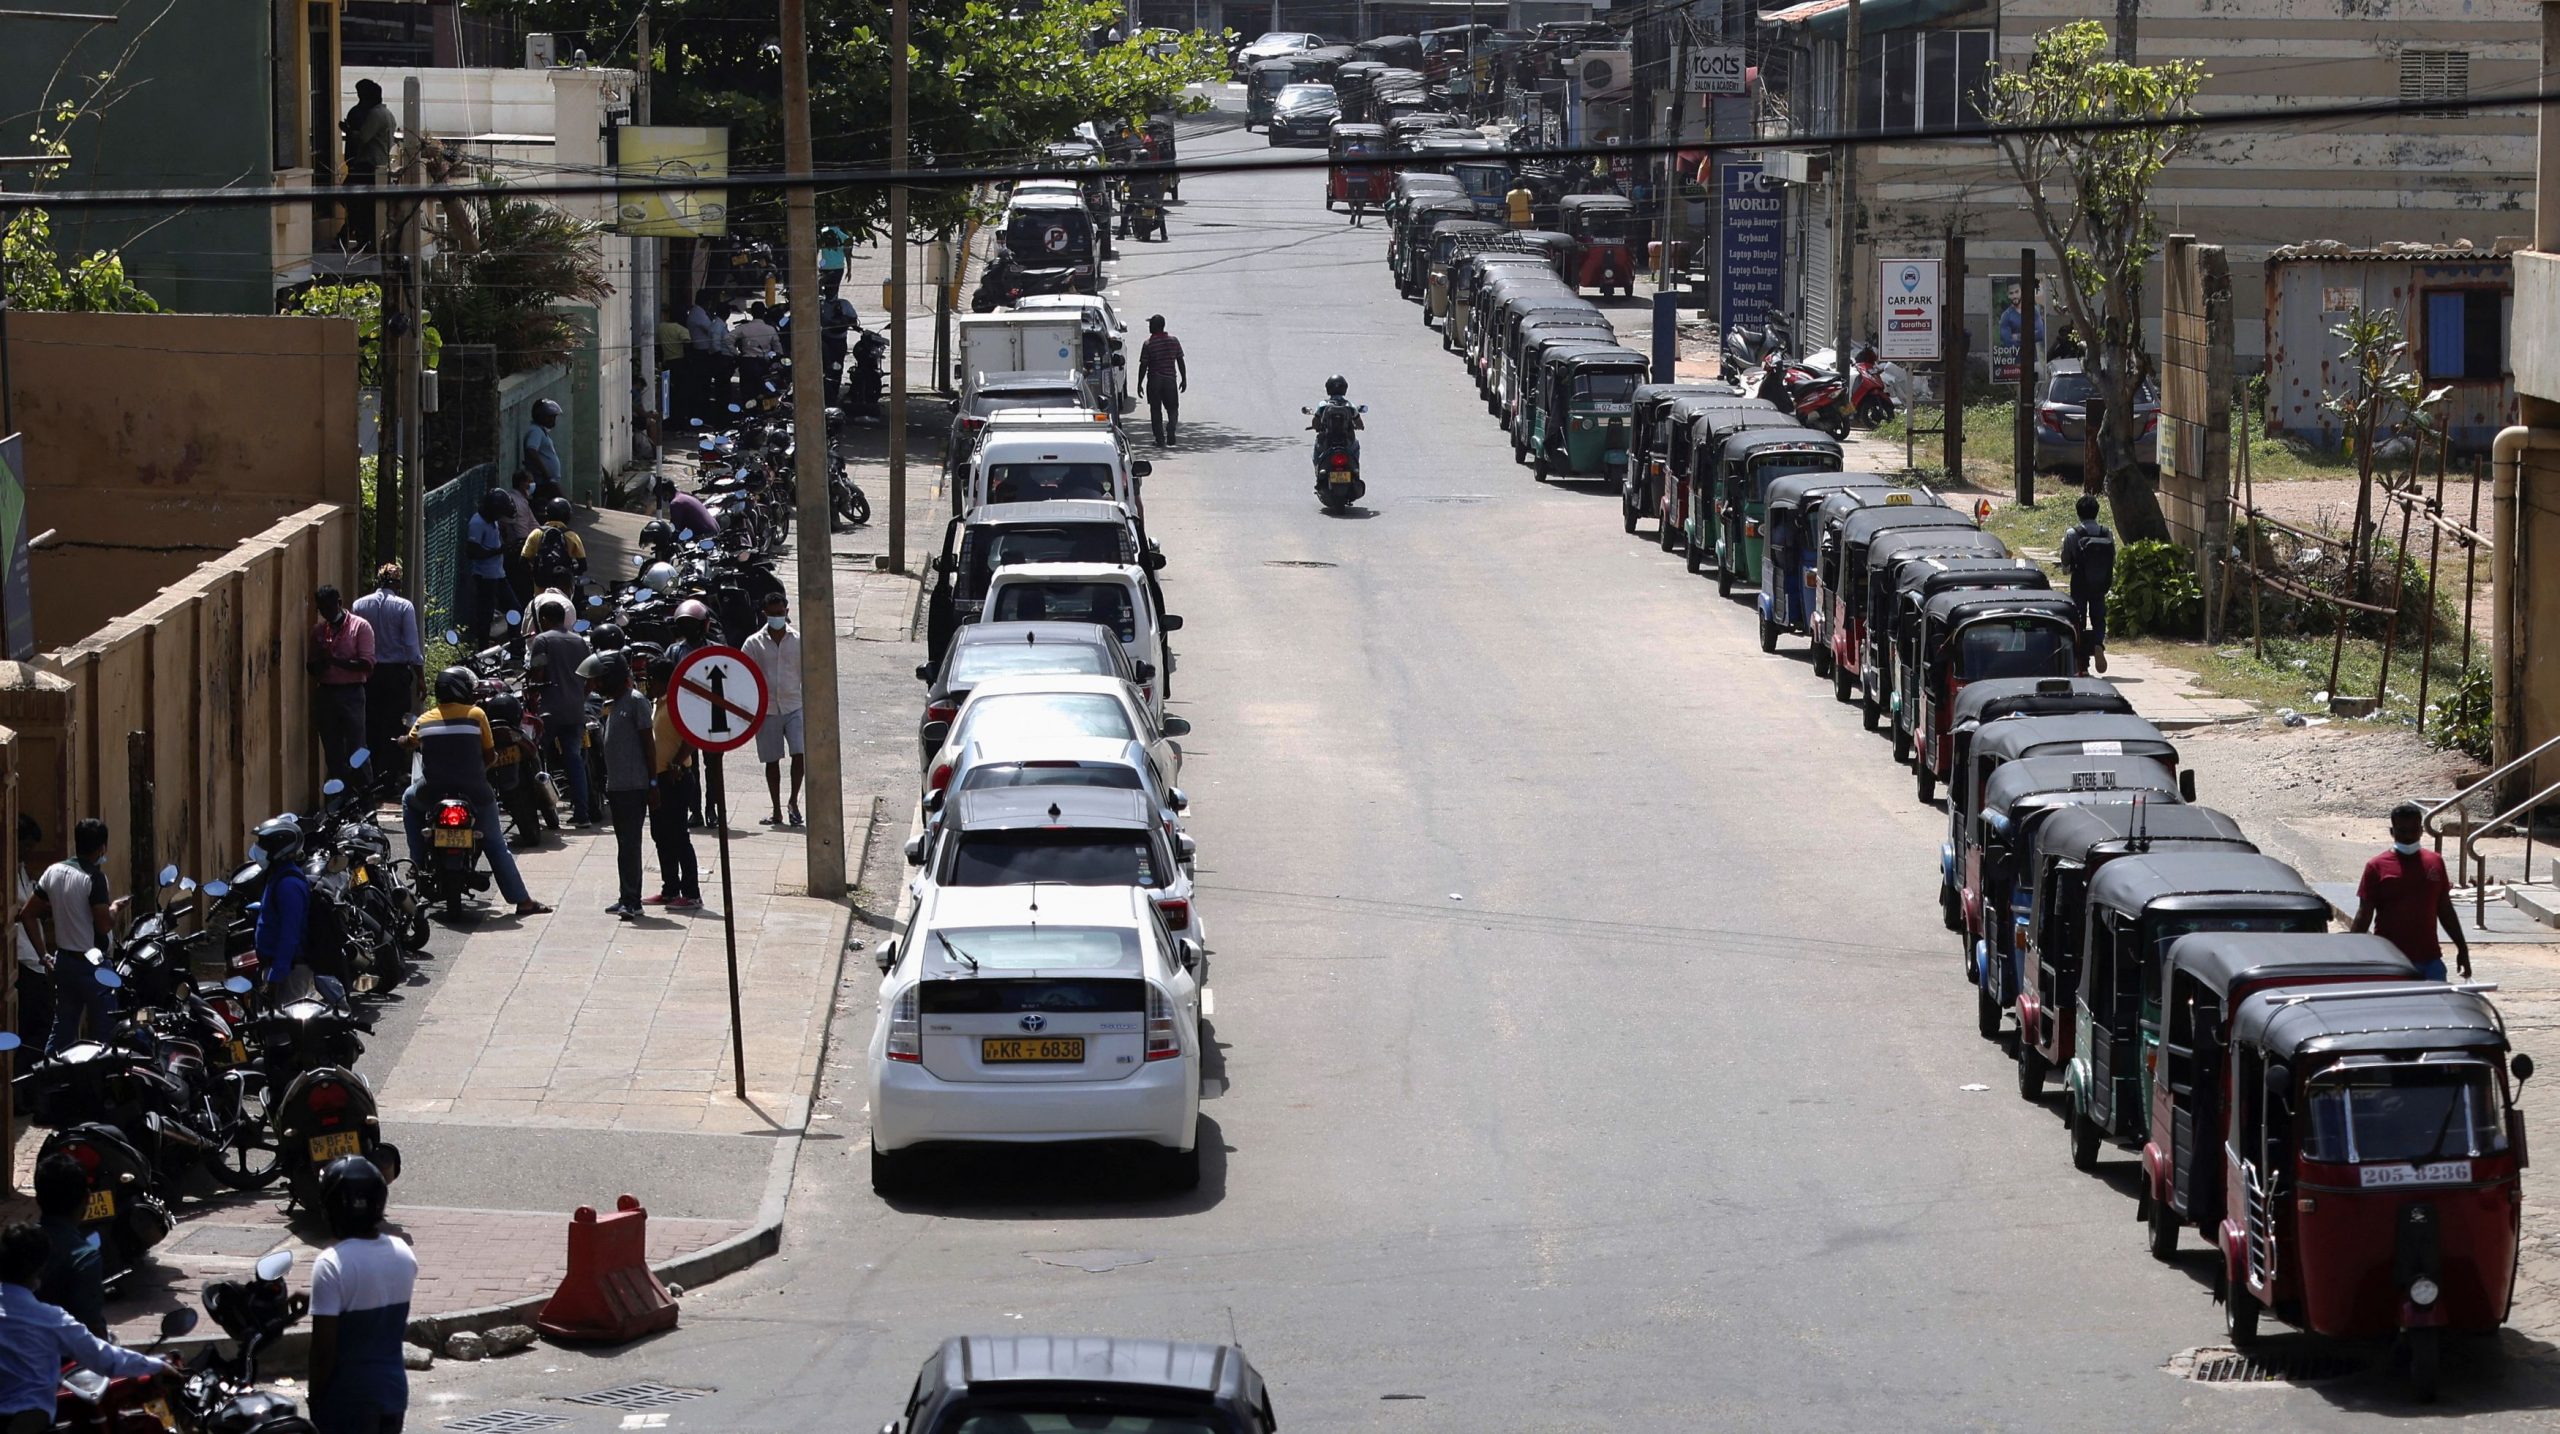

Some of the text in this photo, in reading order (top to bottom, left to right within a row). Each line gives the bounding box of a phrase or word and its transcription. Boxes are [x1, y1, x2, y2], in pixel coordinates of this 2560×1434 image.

[1695, 53, 1739, 74] roots
[1695, 81, 1710, 90] SALON
[1717, 81, 1739, 90] ACADEMY
[1737, 171, 1771, 193] PC
[1728, 198, 1780, 211] WORLD
[1729, 218, 1778, 228] Laptop Battery
[1738, 234, 1769, 244] Keyboard
[1729, 250, 1778, 260] Laptop Display
[1728, 266, 1778, 277] Laptop Charger
[1733, 282, 1773, 292] Laptop Ram
[1733, 298, 1749, 307] Used
[1888, 296, 1933, 305] CAR PARK
[1733, 314, 1744, 323] All
[1745, 314, 1763, 323] kind
[1993, 345, 2020, 356] Sporty
[1993, 356, 2016, 365] Wear
[1890, 495, 1908, 503] TAXI
[2072, 771, 2116, 787] METERE TAXI
[1000, 1042, 1022, 1058] KR
[1041, 1042, 1081, 1058] 6838
[2364, 1164, 2469, 1184] 205-8236
